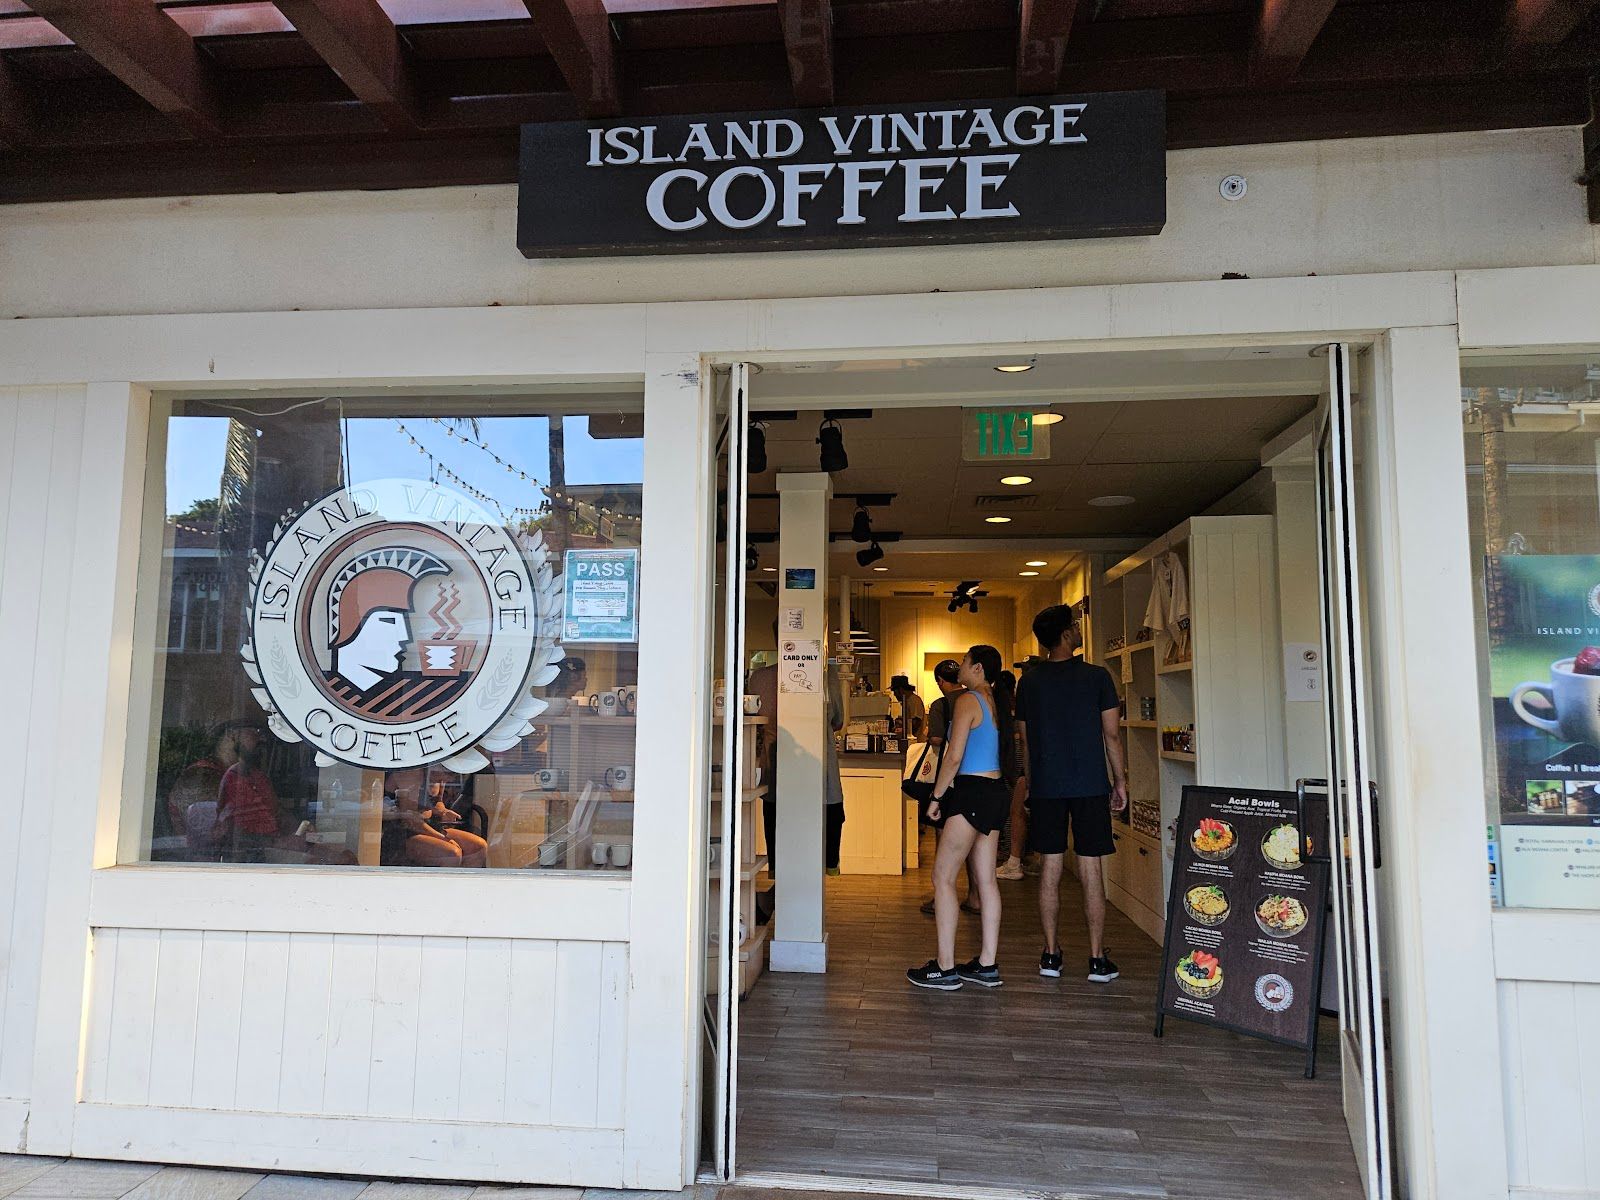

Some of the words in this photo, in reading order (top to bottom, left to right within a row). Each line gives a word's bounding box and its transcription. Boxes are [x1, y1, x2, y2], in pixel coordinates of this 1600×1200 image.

[586, 118, 804, 167] ISLAND
[819, 103, 1088, 156] VINTAGE
[645, 153, 1021, 232] COFFEE
[259, 488, 378, 623] ISLAND
[401, 484, 527, 631] VINTAGE
[576, 562, 625, 577] PASS
[1537, 627, 1582, 635] ISLAND
[304, 709, 470, 762] COFFEE
[1545, 764, 1571, 772] Coffee
[1228, 797, 1249, 806] Acai
[1251, 799, 1280, 808] Bowls
[926, 971, 942, 979] HOKA
